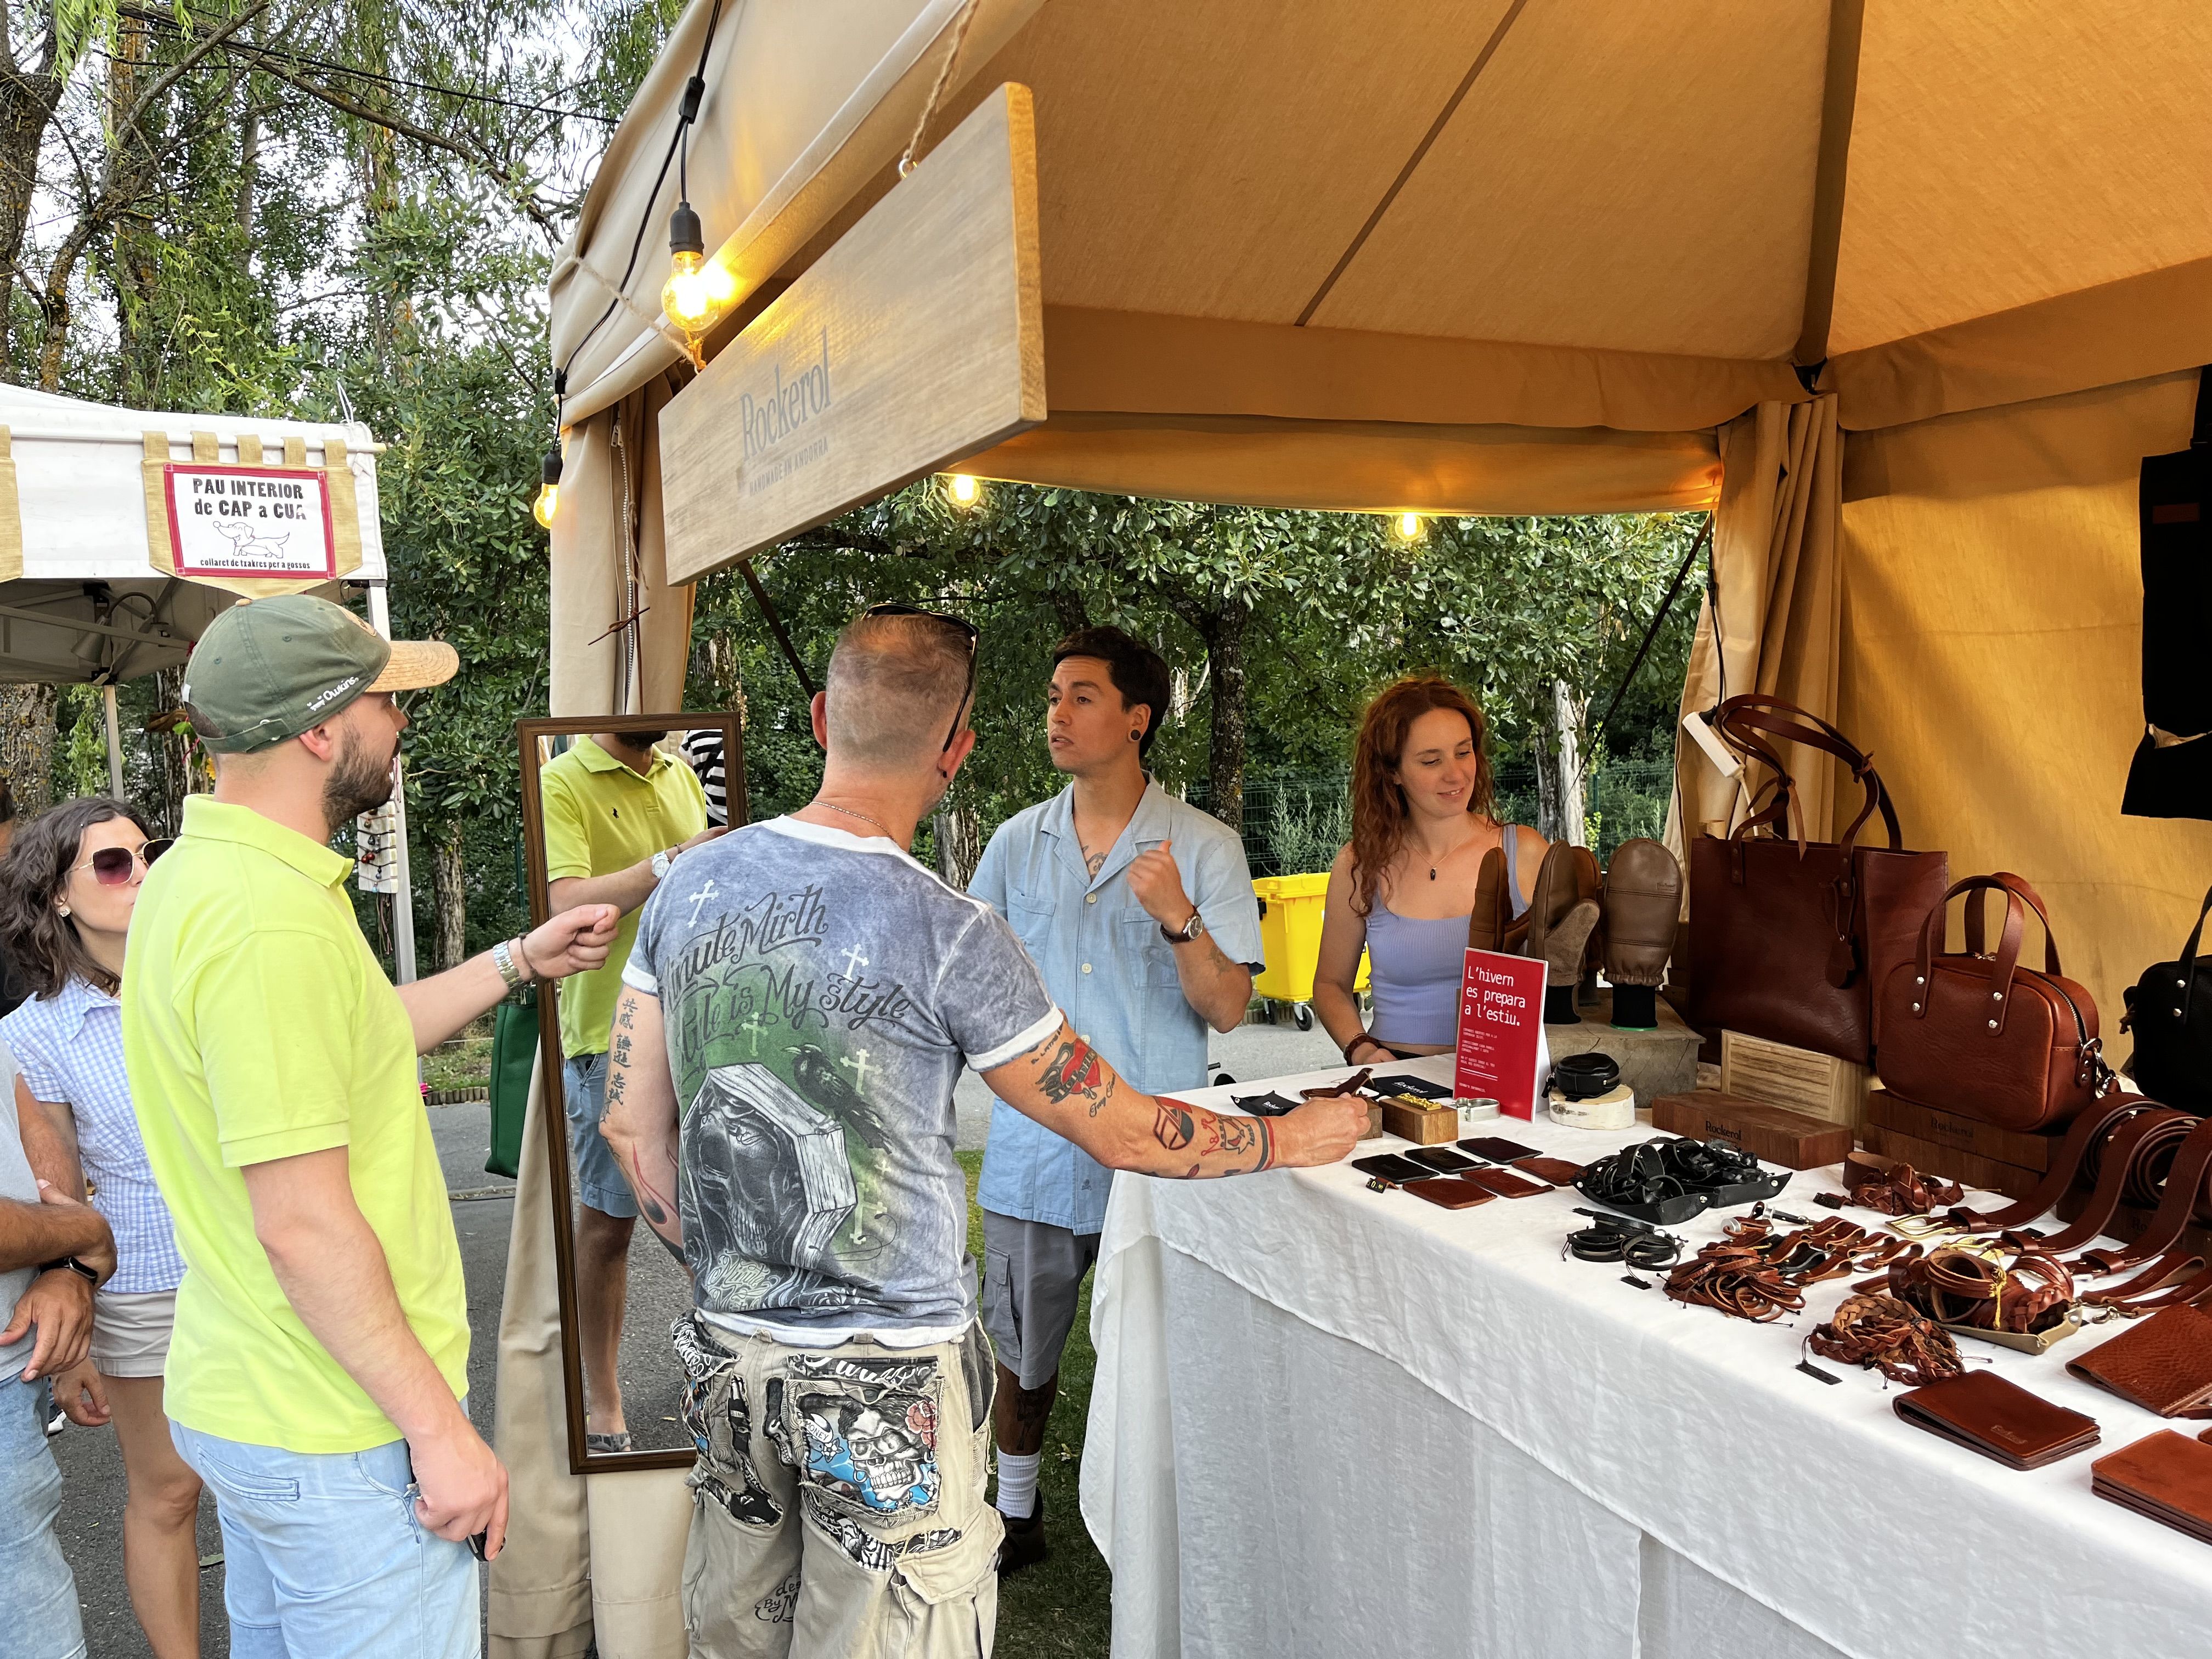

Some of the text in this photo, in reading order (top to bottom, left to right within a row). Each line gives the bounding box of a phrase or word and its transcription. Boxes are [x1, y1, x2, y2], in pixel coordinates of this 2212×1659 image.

[741, 324, 831, 462] Rockerol
[749, 436, 828, 496] HANDMADE IN ANDORRA
[193, 478, 304, 499] PAU INTERIOR
[195, 498, 307, 520] de CAP a CUA
[200, 558, 229, 567] collaret
[231, 558, 239, 567] de
[240, 559, 267, 568] txakres
[269, 560, 280, 569] per
[287, 561, 311, 570] gossos
[323, 676, 356, 701] Owkins
[731, 884, 829, 964] Mirth
[1468, 965, 1514, 987] L'hivern
[729, 983, 754, 1024] is
[758, 963, 829, 1030] My
[1466, 986, 1526, 1008] es prepara
[1464, 1005, 1471, 1015] a
[1706, 1120, 1741, 1141] Rockerol
[804, 1418, 829, 1440] MONEY
[764, 1598, 782, 1613] By
